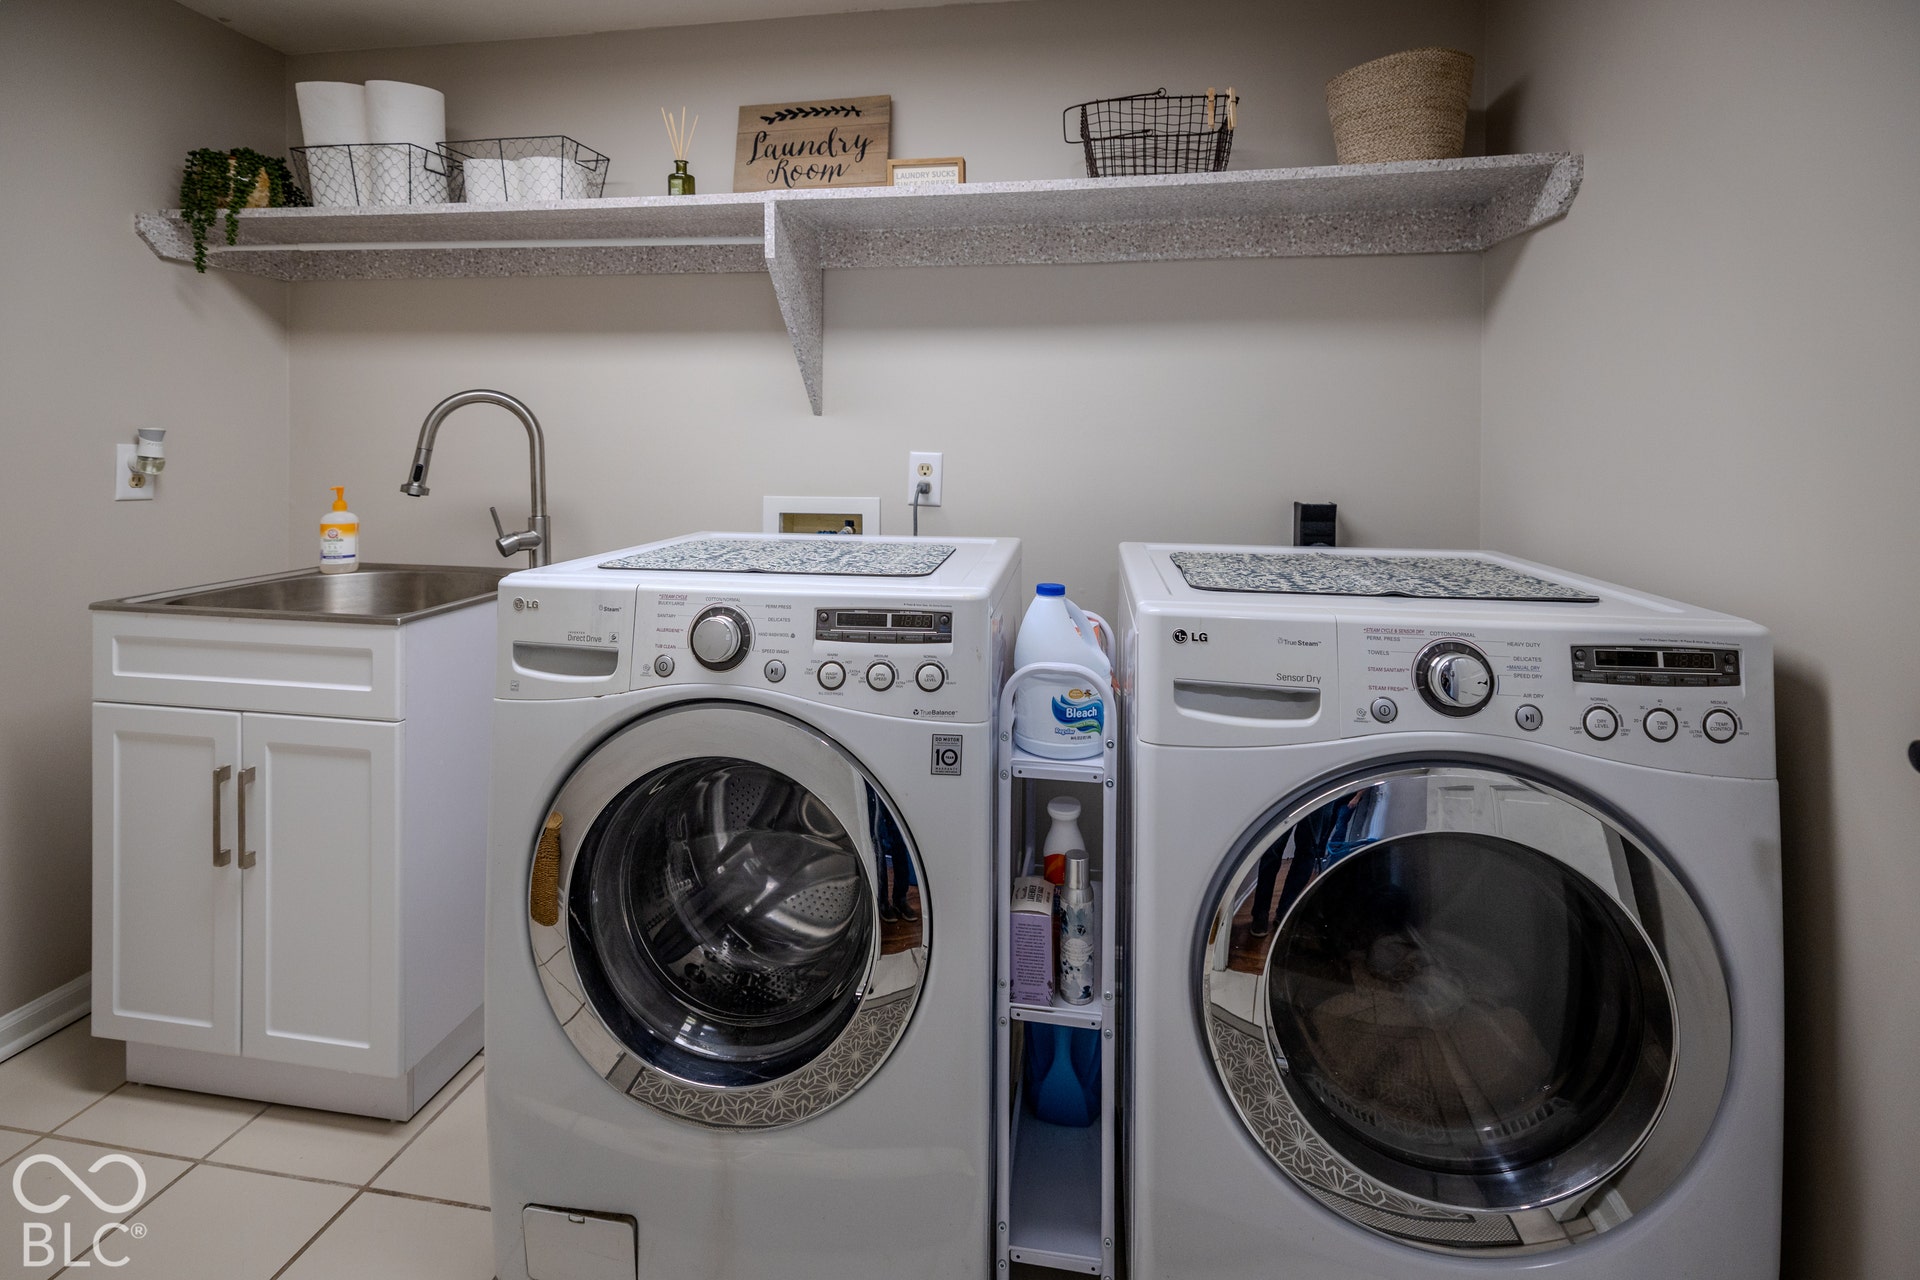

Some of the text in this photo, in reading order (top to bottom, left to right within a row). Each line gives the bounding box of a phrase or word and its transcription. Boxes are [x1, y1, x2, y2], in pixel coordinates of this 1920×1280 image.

[746, 127, 873, 166] Laundry
[766, 158, 850, 188] Room
[895, 169, 956, 180] LAUNDRY SUCKS
[526, 600, 539, 610] LG
[567, 634, 585, 642] Direct
[585, 634, 602, 643] Drive
[1191, 632, 1208, 643] LG
[1429, 630, 1476, 638] COTTON/NORMAL
[1276, 672, 1322, 685] Sensor Dry
[1066, 706, 1098, 718] Bleach
[935, 748, 959, 767] 10
